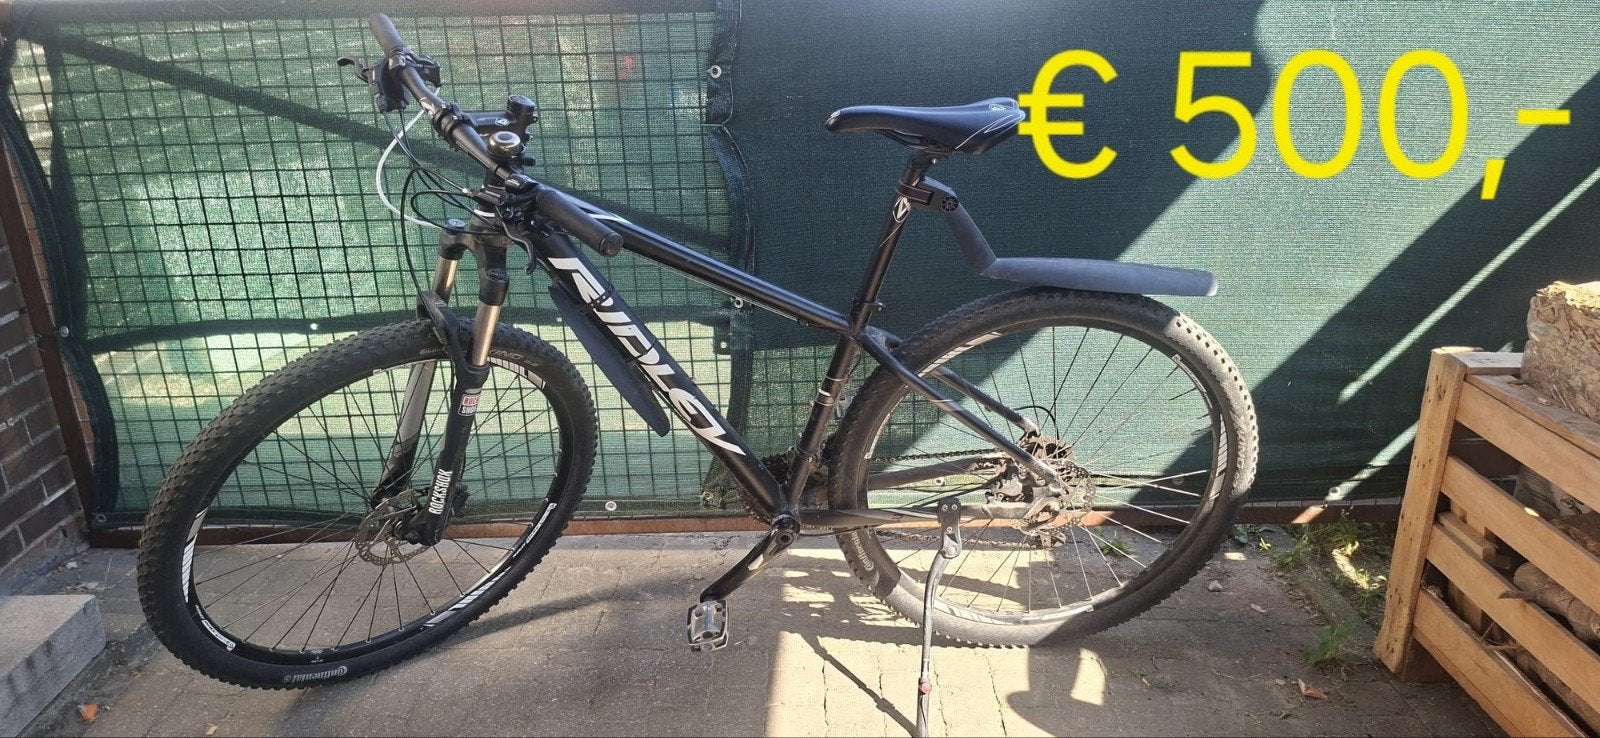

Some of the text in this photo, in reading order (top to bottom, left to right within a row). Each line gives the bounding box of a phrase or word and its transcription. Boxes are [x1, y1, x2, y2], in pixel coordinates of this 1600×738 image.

[547, 257, 747, 456] RIDLEY
[428, 468, 454, 515] ROCKSHOX
[292, 665, 348, 683] Continental
